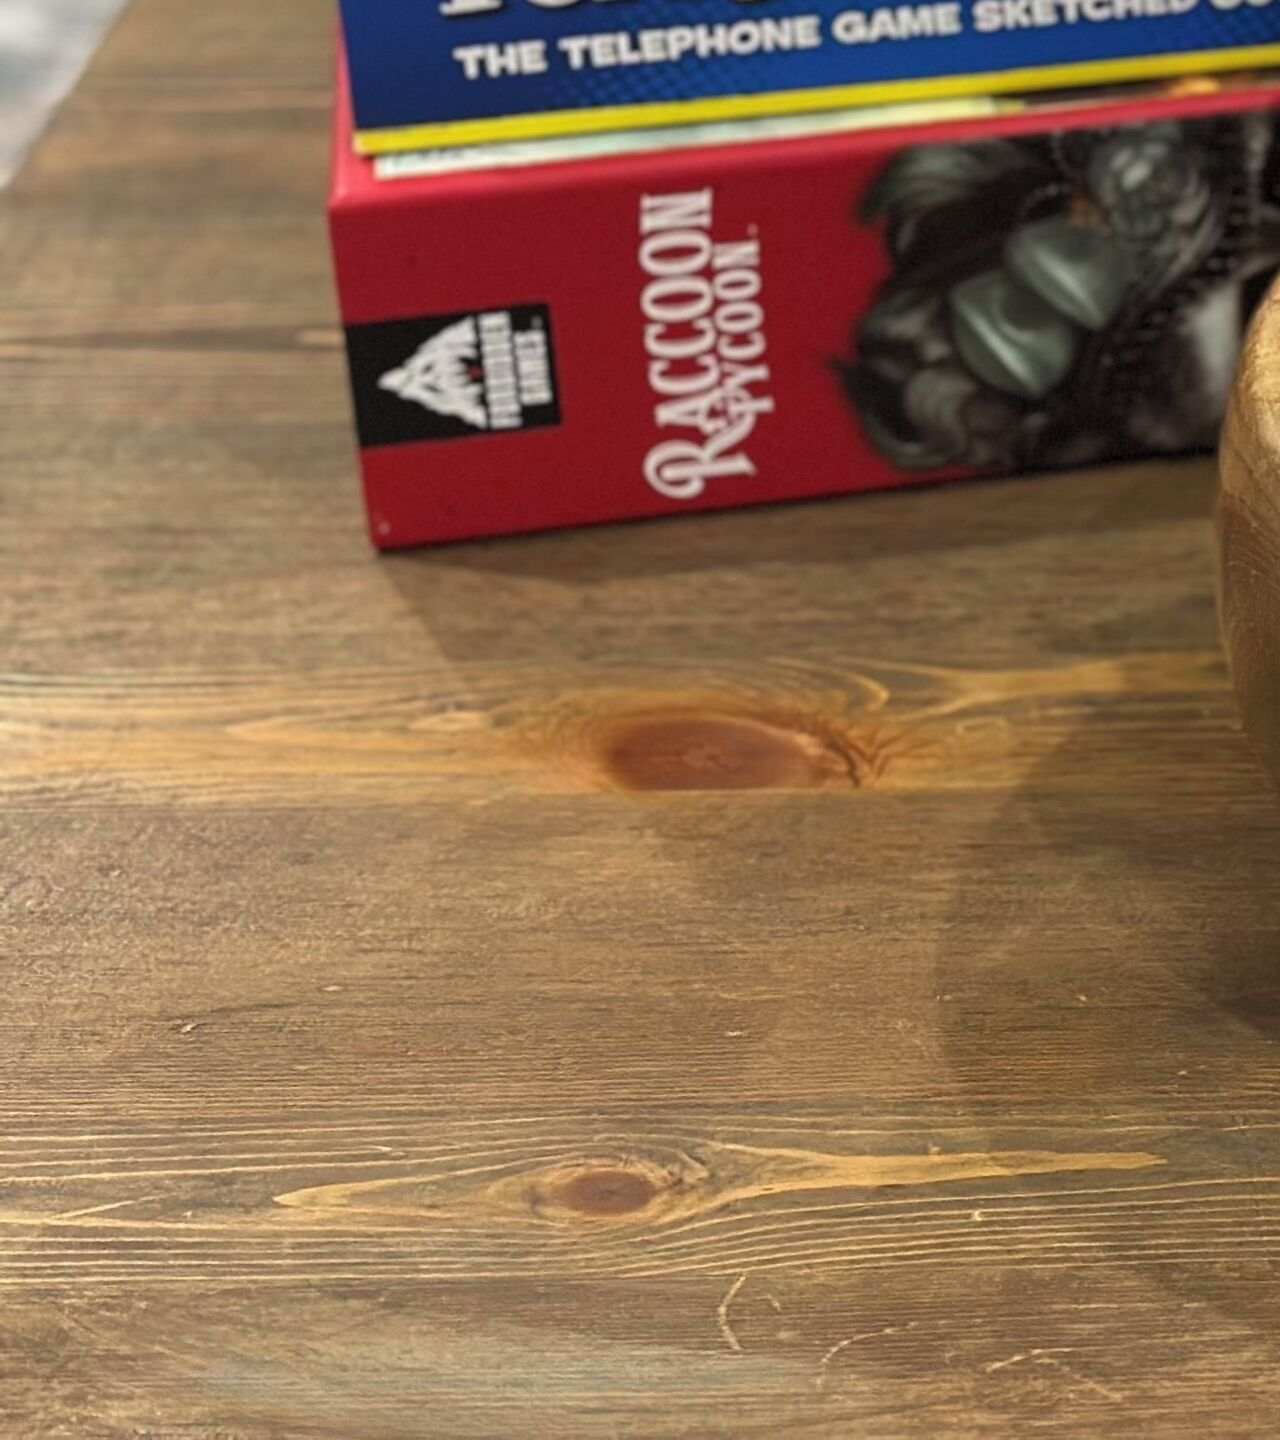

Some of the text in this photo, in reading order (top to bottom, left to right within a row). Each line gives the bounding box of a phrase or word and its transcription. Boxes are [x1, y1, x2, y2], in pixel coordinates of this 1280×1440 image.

[453, 41, 548, 80] THE
[557, 15, 822, 72] TELEPHONE
[832, 2, 963, 46] GAME
[638, 187, 757, 500] RACCOON
